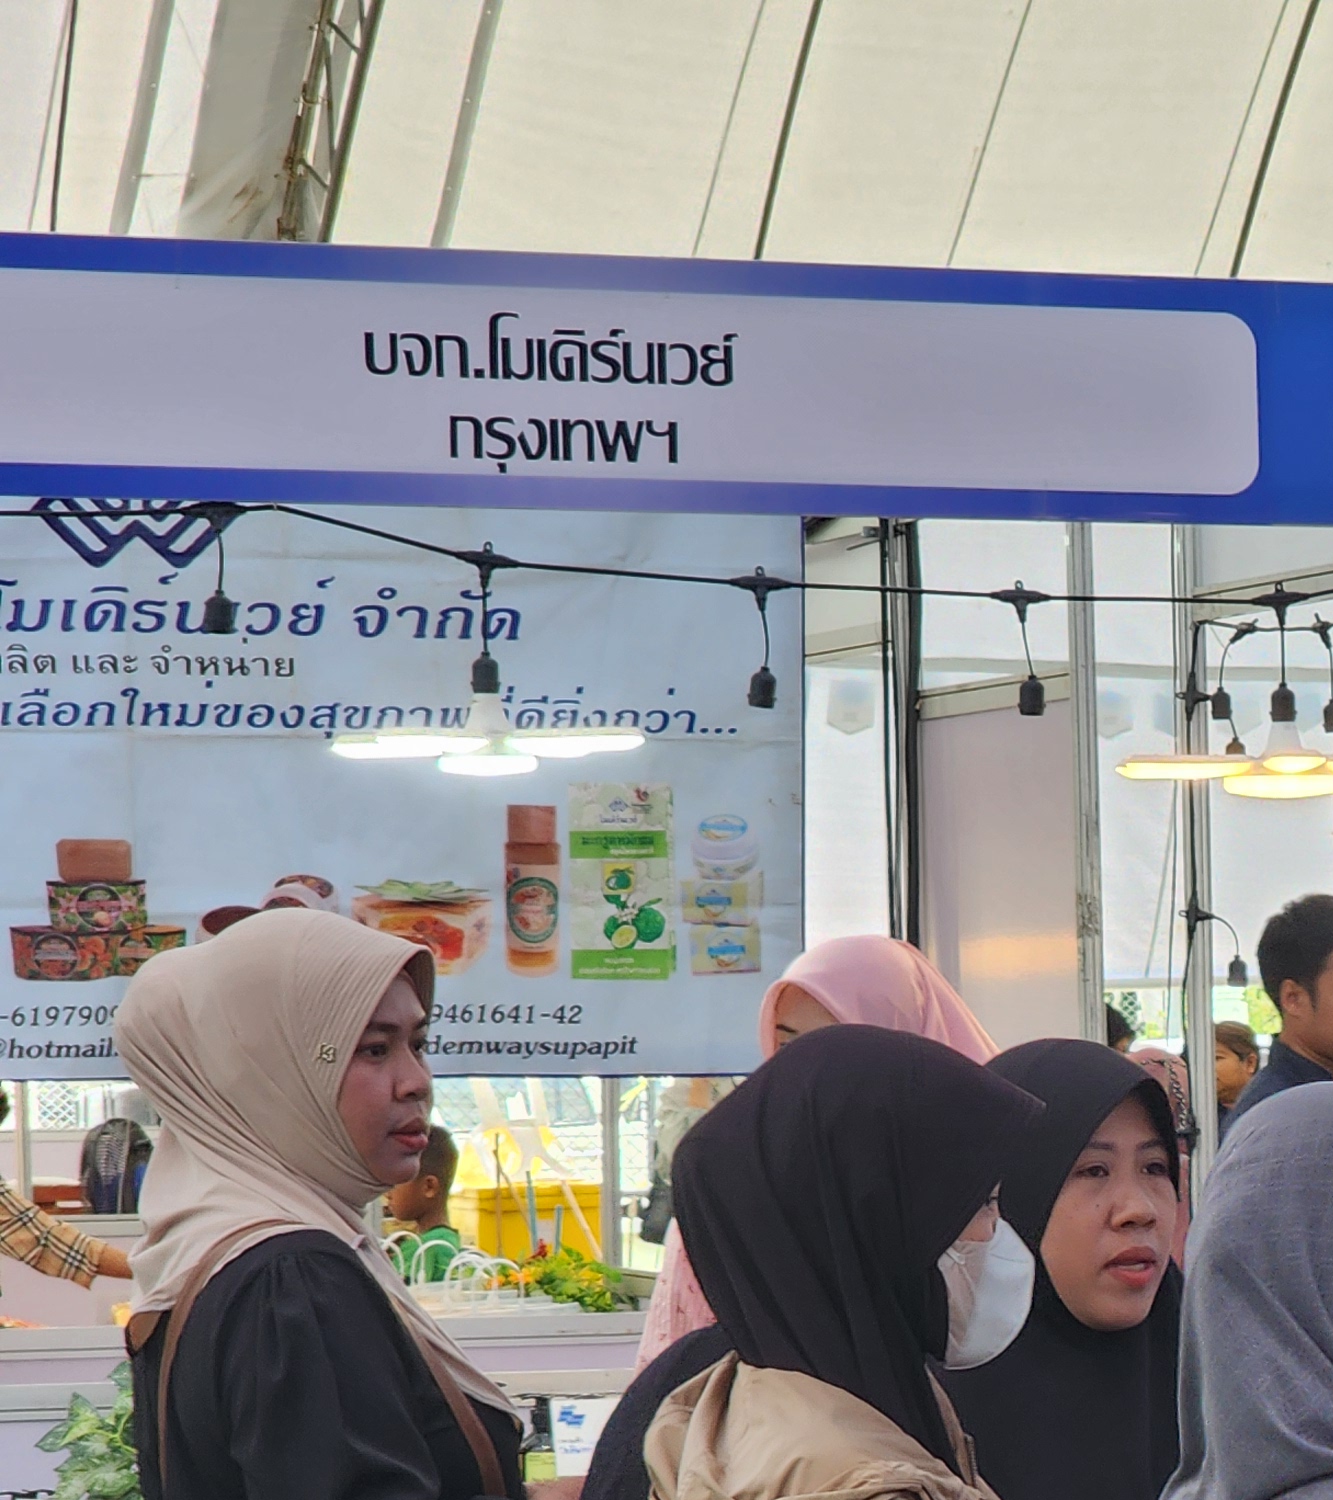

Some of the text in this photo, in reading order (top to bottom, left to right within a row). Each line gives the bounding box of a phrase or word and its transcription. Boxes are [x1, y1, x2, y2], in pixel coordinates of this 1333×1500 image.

[363, 311, 739, 387] บจก.โมเดิร์นเวย์
[449, 414, 679, 474] กรุงเทพฯ
[0, 635, 296, 678] ลิต และ จำหน่าย
